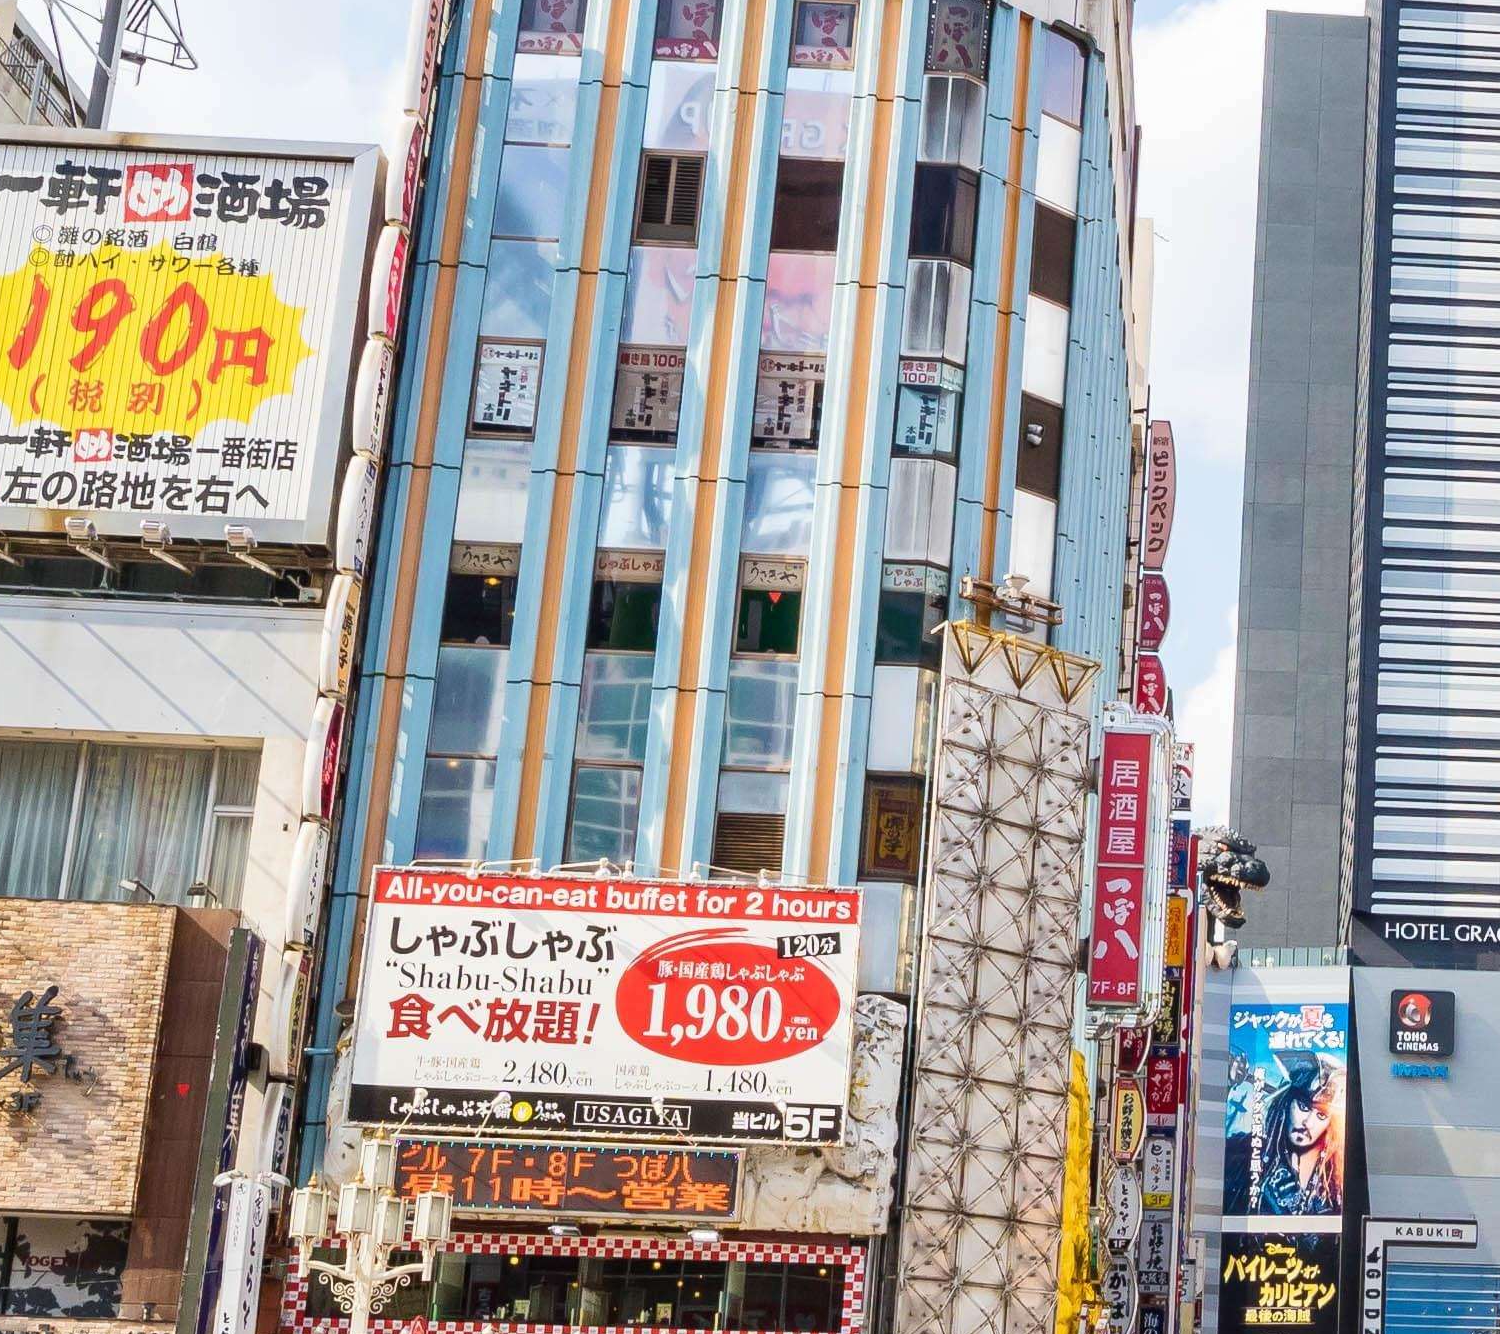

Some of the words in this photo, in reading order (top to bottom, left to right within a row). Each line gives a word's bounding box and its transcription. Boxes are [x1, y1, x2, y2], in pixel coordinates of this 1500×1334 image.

[174, 232, 218, 252] 白鶴
[53, 249, 260, 278] 酎ハイ・サワー各種
[5, 274, 276, 388] 190円
[0, 466, 270, 514] 左の路地を右へ
[1106, 758, 1141, 857] 居酒屋
[384, 881, 598, 909] All-you-can-eat
[605, 888, 688, 915] buffet
[697, 893, 736, 916] for
[745, 896, 763, 916] 2
[772, 897, 853, 921] hours
[389, 917, 619, 963] しゃぶしゃぶ
[780, 933, 838, 958] 120分
[1384, 921, 1450, 942] HOTEL
[642, 983, 783, 1047] 1,980
[783, 1024, 819, 1045] yen
[1396, 1031, 1428, 1041] TOHO
[1396, 1041, 1439, 1051] CINEMAS
[502, 1059, 569, 1090] 2,480
[567, 1074, 594, 1090] yen
[731, 1111, 780, 1131] 当ビル
[785, 1104, 836, 1139] 5F
